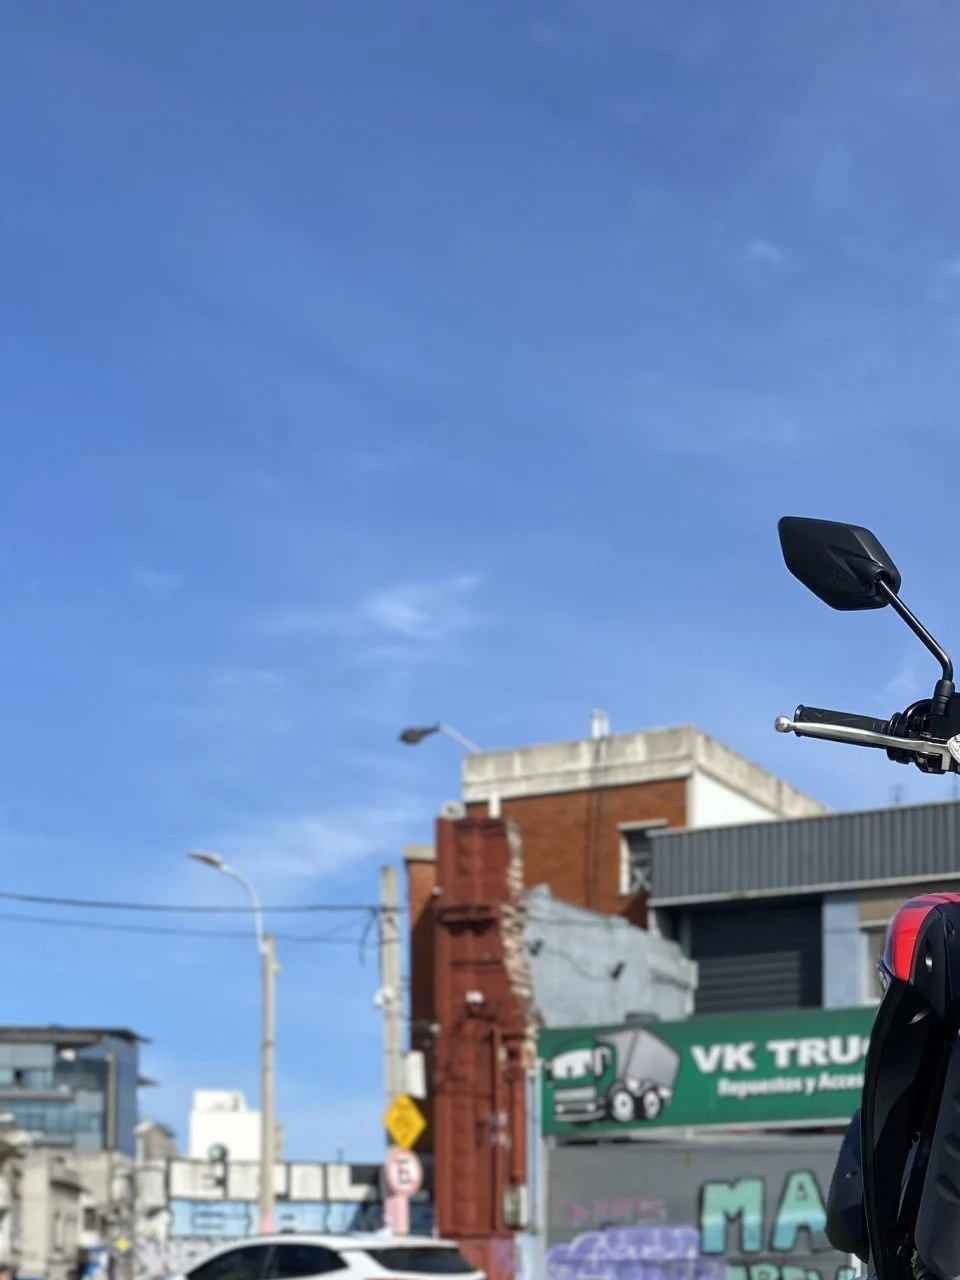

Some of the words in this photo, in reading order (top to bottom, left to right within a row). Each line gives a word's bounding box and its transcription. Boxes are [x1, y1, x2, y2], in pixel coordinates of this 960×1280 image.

[690, 1041, 757, 1074] VK
[717, 1075, 802, 1099] Repuestos
[804, 1077, 816, 1096] y
